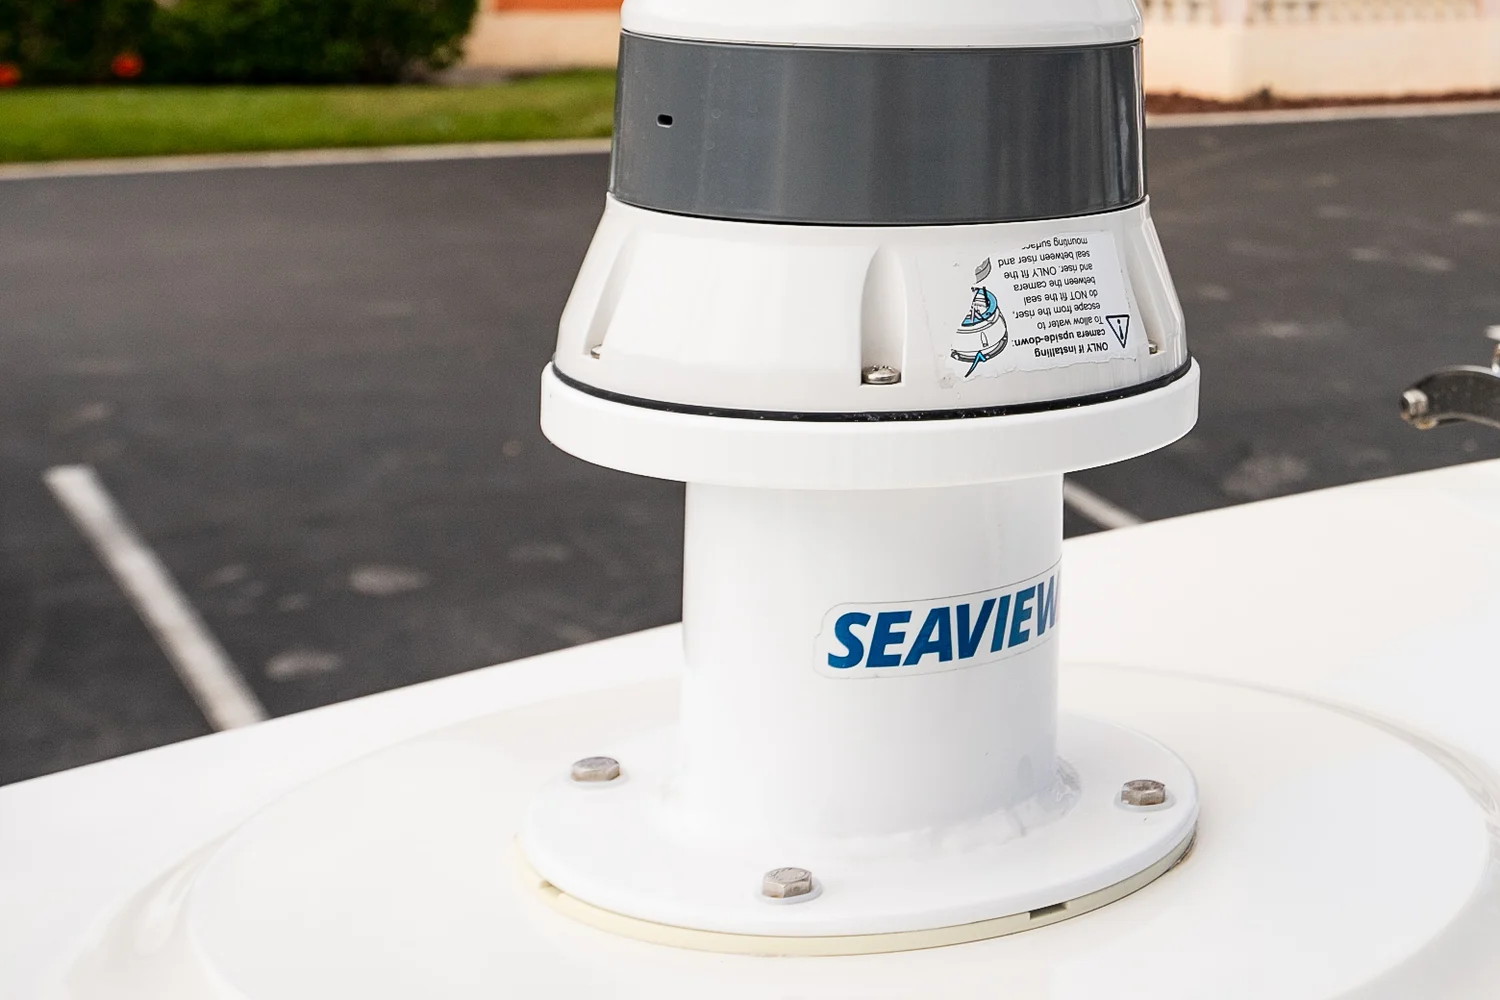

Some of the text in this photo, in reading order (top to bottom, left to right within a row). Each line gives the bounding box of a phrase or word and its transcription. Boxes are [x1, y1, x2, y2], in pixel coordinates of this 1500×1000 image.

[1054, 237, 1088, 247] mounting
[998, 251, 1090, 268] seal between riser and
[1032, 266, 1057, 277] ONLY
[1080, 263, 1093, 272] and
[1004, 271, 1018, 279] the
[1021, 269, 1030, 278] fit
[1013, 276, 1096, 291] between the camera
[1060, 292, 1068, 300] fit
[1070, 290, 1088, 299] NOT
[1089, 289, 1098, 298] do
[1024, 295, 1041, 305] seal
[1038, 307, 1051, 316] the
[1054, 305, 1072, 314] from
[1074, 302, 1100, 313] escape
[1037, 316, 1103, 330] To allow water to
[1012, 331, 1074, 347] upside-down:
[1035, 342, 1108, 357] ONLY if installing
[827, 569, 1060, 668] SEAVIEW
